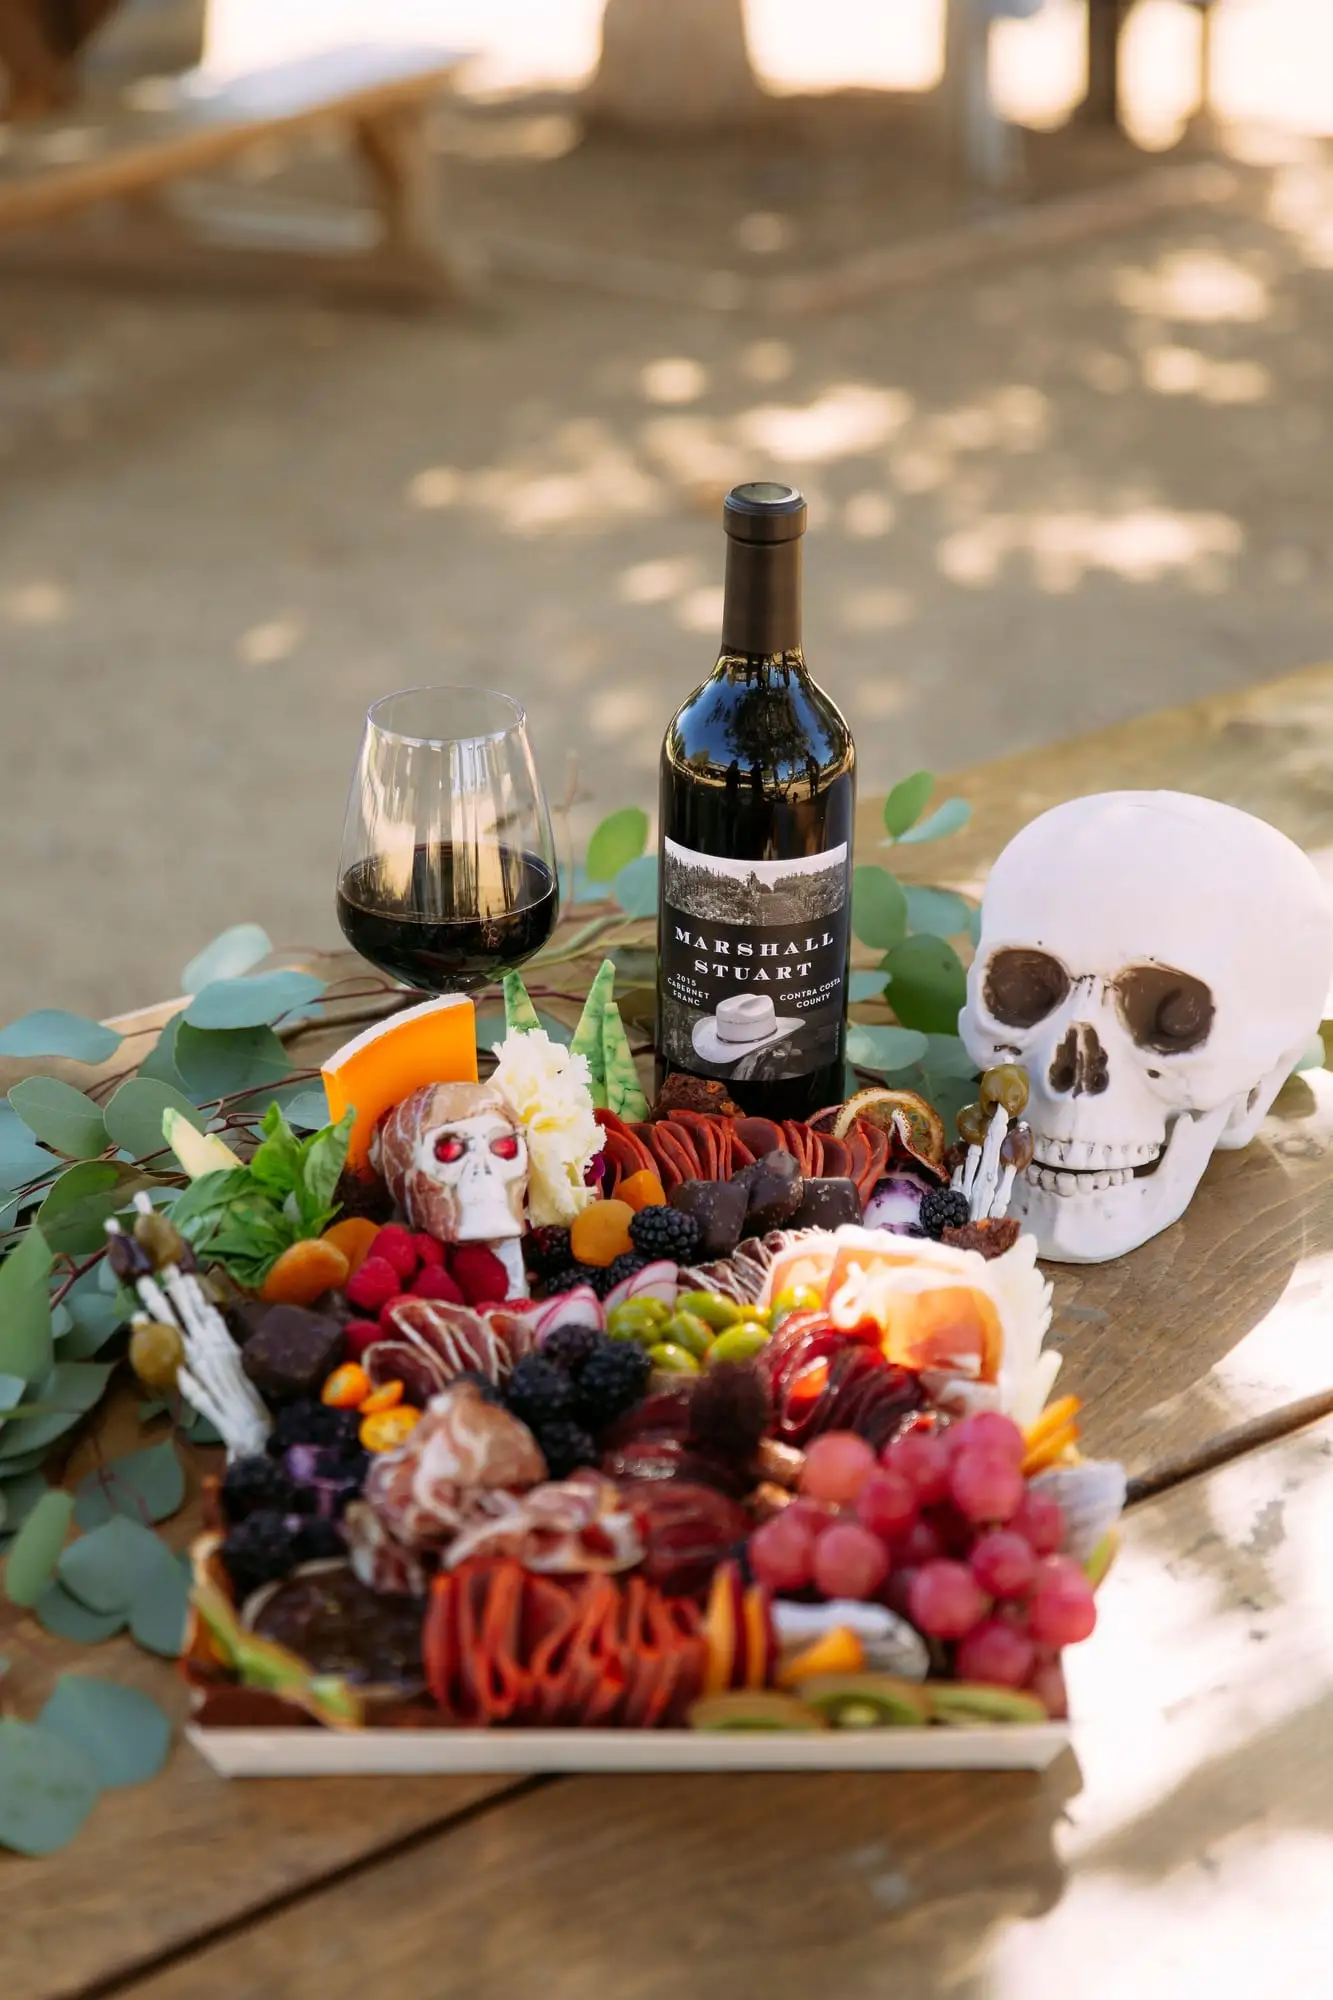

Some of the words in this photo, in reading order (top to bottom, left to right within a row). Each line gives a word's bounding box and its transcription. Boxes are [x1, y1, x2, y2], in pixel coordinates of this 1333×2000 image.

[675, 926, 834, 957] MARSHALL
[676, 973, 697, 987] 2015
[694, 959, 812, 981] STUART
[667, 977, 710, 1000] CABERNET
[673, 989, 701, 1007] FRANC
[779, 988, 818, 1001] CONTRA
[819, 977, 841, 992] COSTA
[796, 992, 831, 1009] COUNTY
